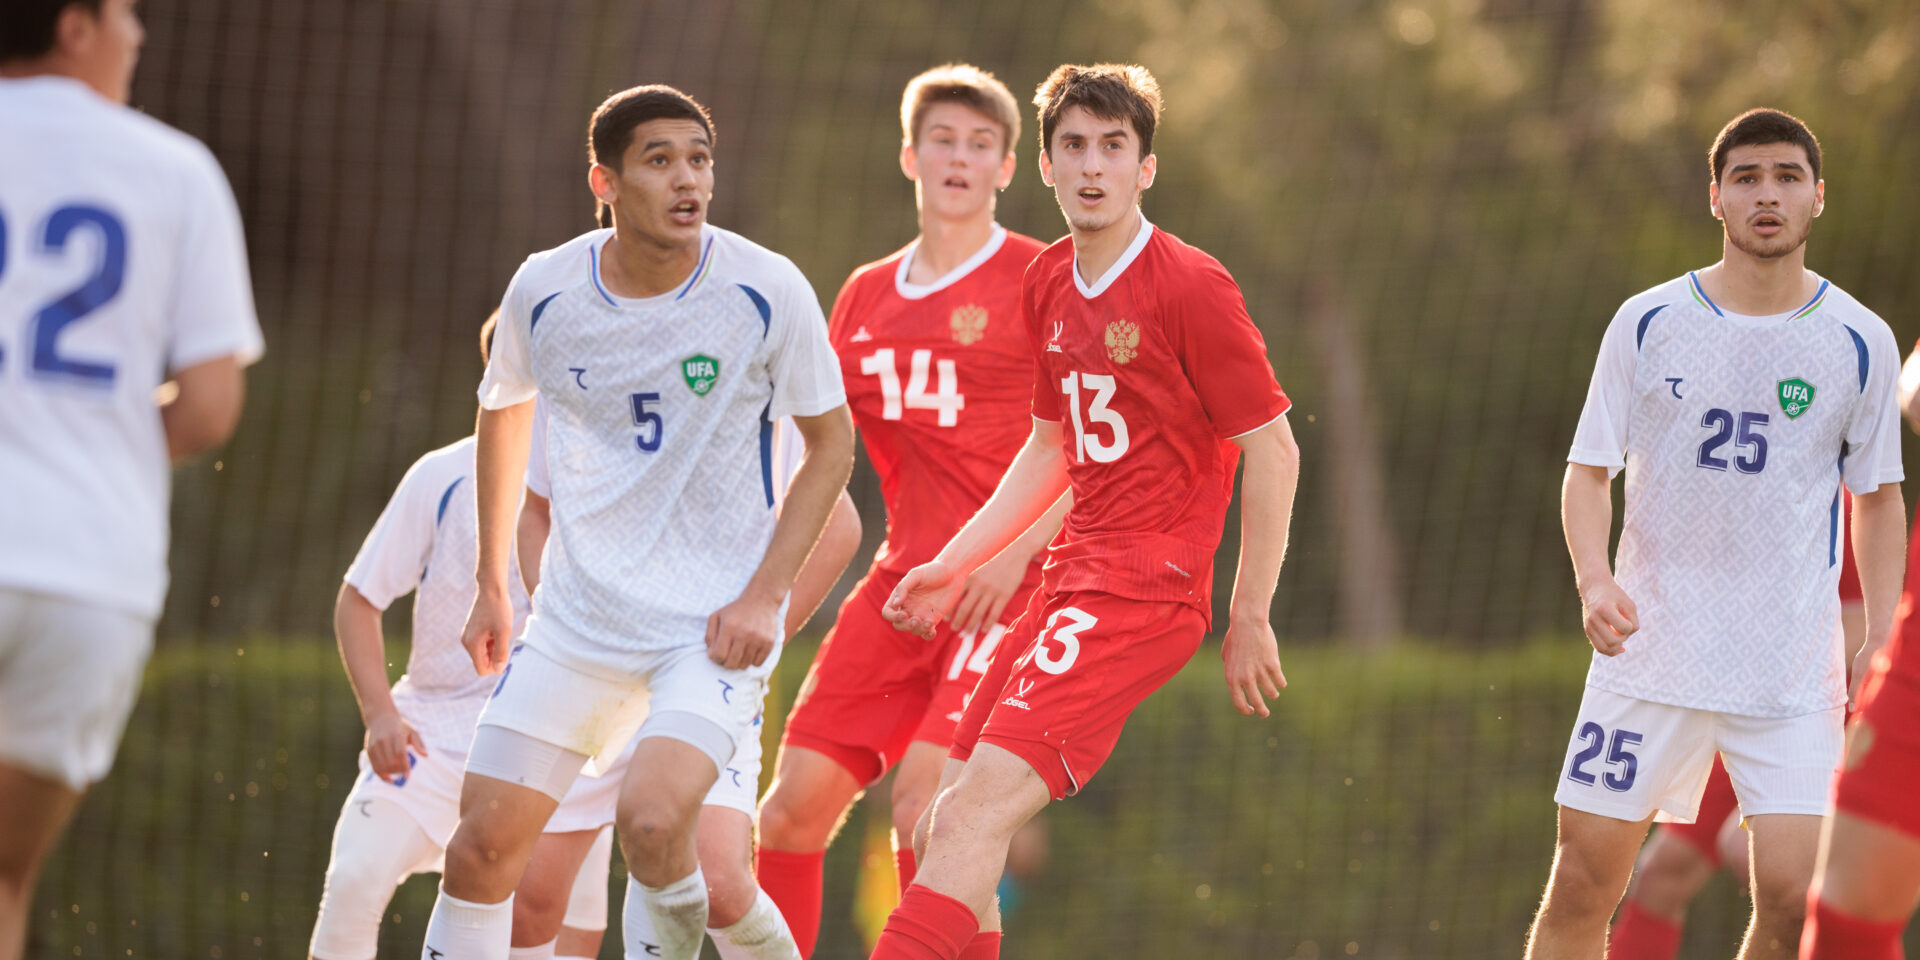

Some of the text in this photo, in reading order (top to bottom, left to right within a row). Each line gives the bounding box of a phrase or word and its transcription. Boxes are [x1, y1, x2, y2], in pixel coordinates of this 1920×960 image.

[0, 204, 128, 384] 2
[686, 361, 716, 378] UFA
[860, 348, 965, 427] 14
[1782, 384, 1809, 403] UFA
[628, 392, 663, 454] 5
[1061, 370, 1130, 463] 13
[1696, 408, 1769, 475] 25
[1567, 721, 1643, 793] 25
